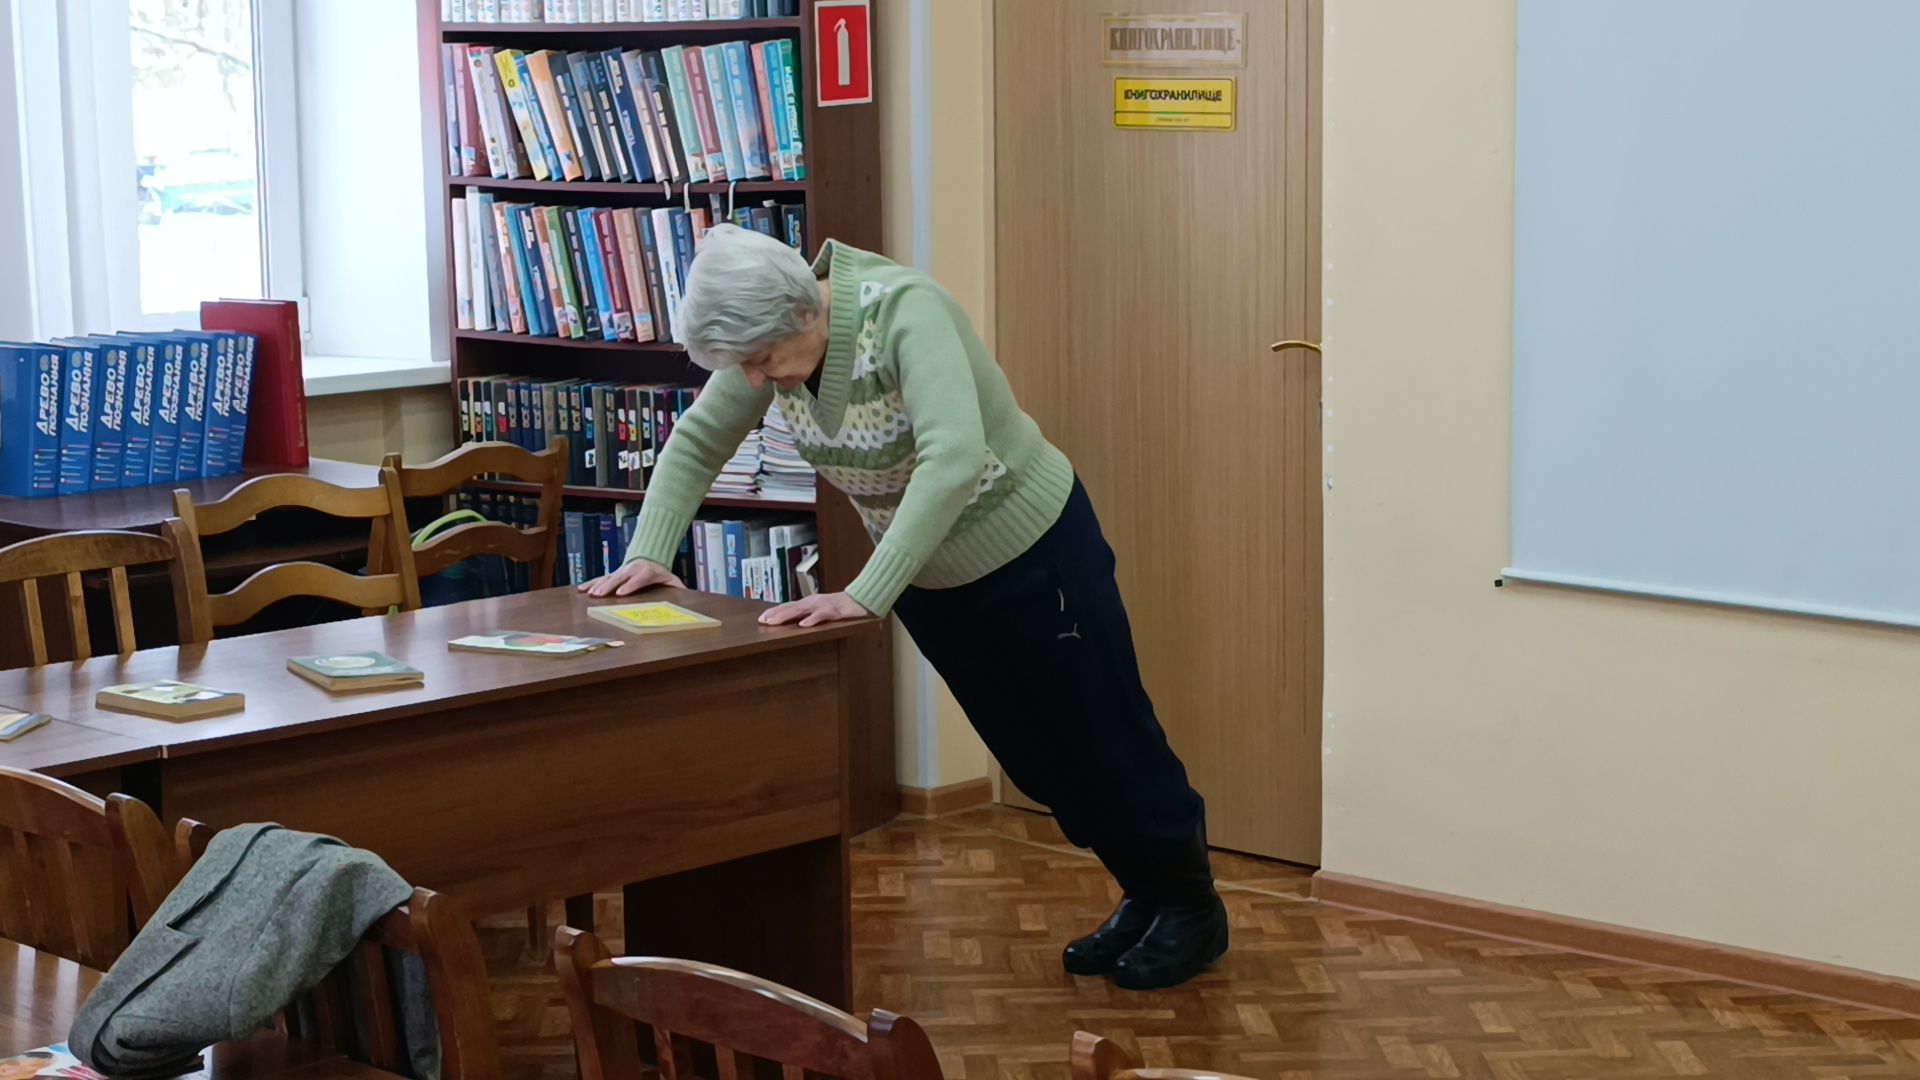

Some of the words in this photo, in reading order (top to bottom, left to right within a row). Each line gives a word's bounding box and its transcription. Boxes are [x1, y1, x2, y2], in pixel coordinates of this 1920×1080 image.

[1124, 89, 1222, 102] КНИГОХРАНИЛИЩЕ
[36, 372, 50, 435] ДРЕВО
[66, 369, 82, 433] ДРЕВО
[99, 367, 116, 430] ДРЕВО
[130, 363, 146, 425] ДРЕВО
[158, 362, 174, 423] ДРЕВО
[184, 359, 199, 420] ДРЕВО
[211, 355, 225, 416] ДРЕВО
[231, 353, 245, 412] ДРЕВО
